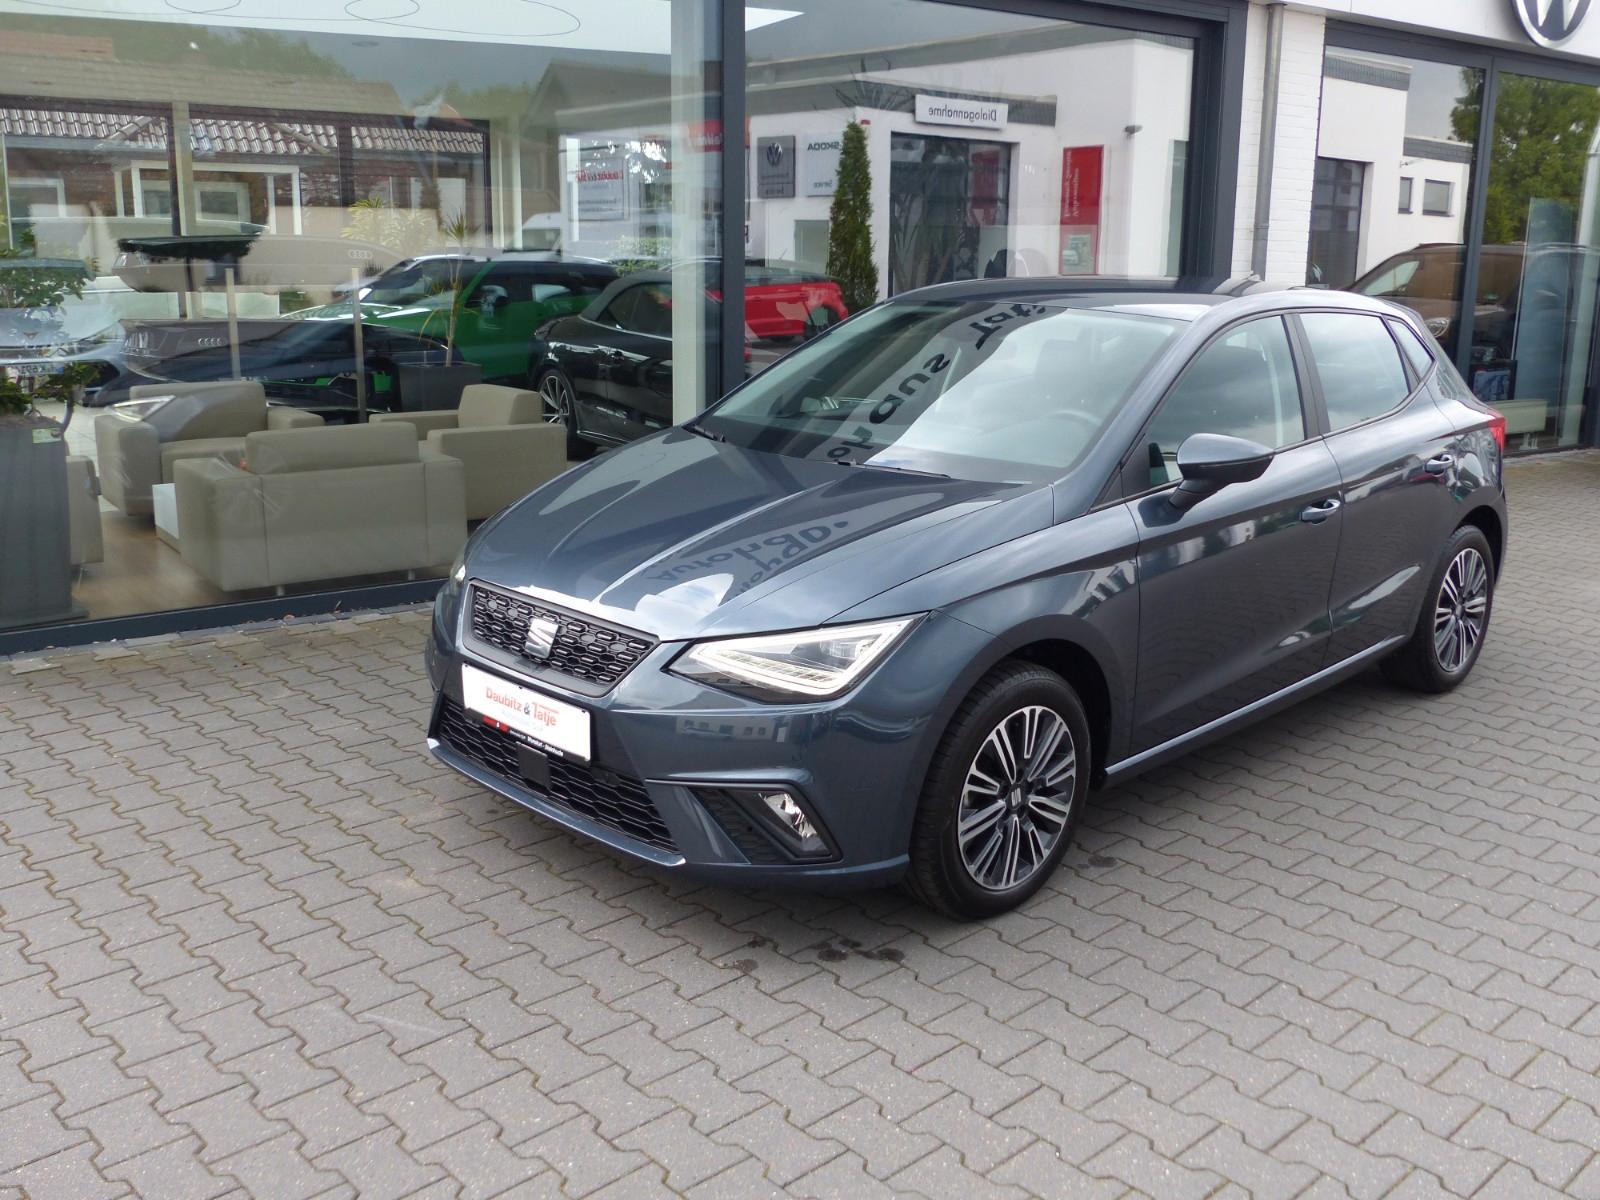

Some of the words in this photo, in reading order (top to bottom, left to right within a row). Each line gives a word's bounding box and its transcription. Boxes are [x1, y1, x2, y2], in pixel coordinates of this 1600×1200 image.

[485, 687, 522, 713] Daubitz
[523, 701, 530, 715] &
[532, 701, 558, 727] Tatje
